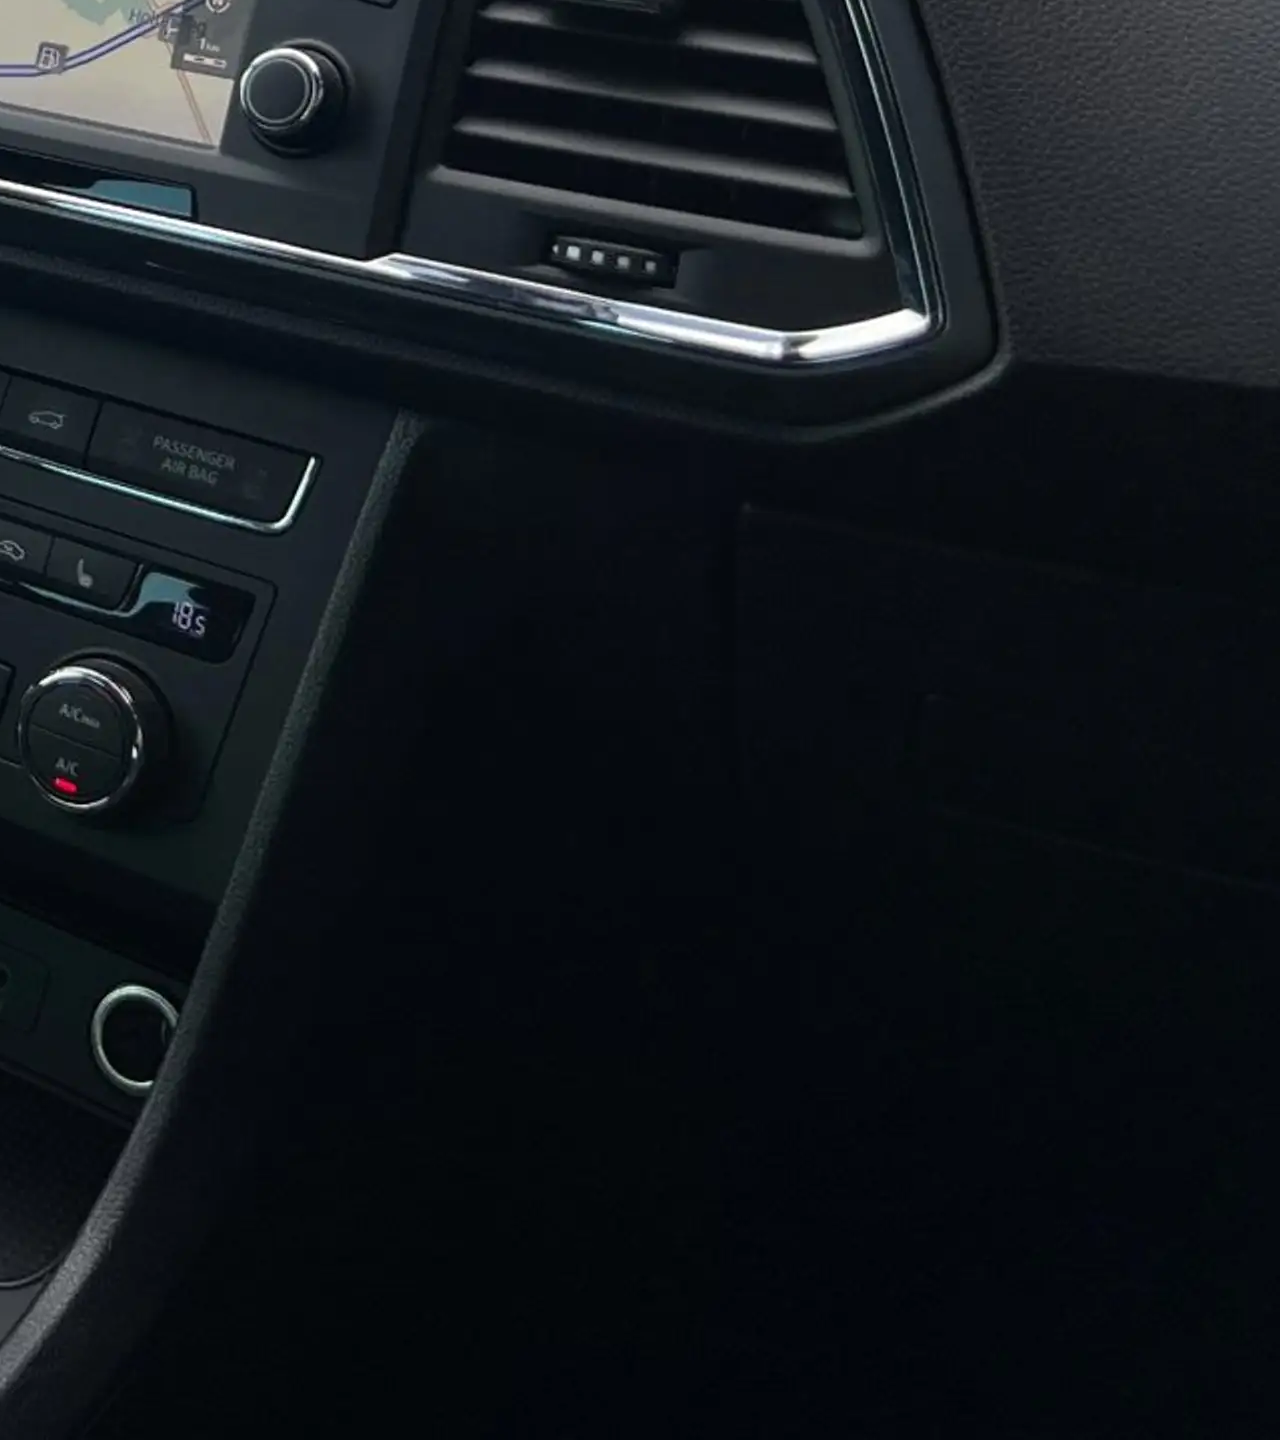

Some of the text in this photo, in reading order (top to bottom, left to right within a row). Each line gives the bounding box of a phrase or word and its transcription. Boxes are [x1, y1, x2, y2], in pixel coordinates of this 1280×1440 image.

[153, 436, 235, 469] PASSENGER
[161, 457, 219, 486] AIR BAG
[56, 758, 78, 777] A/C
